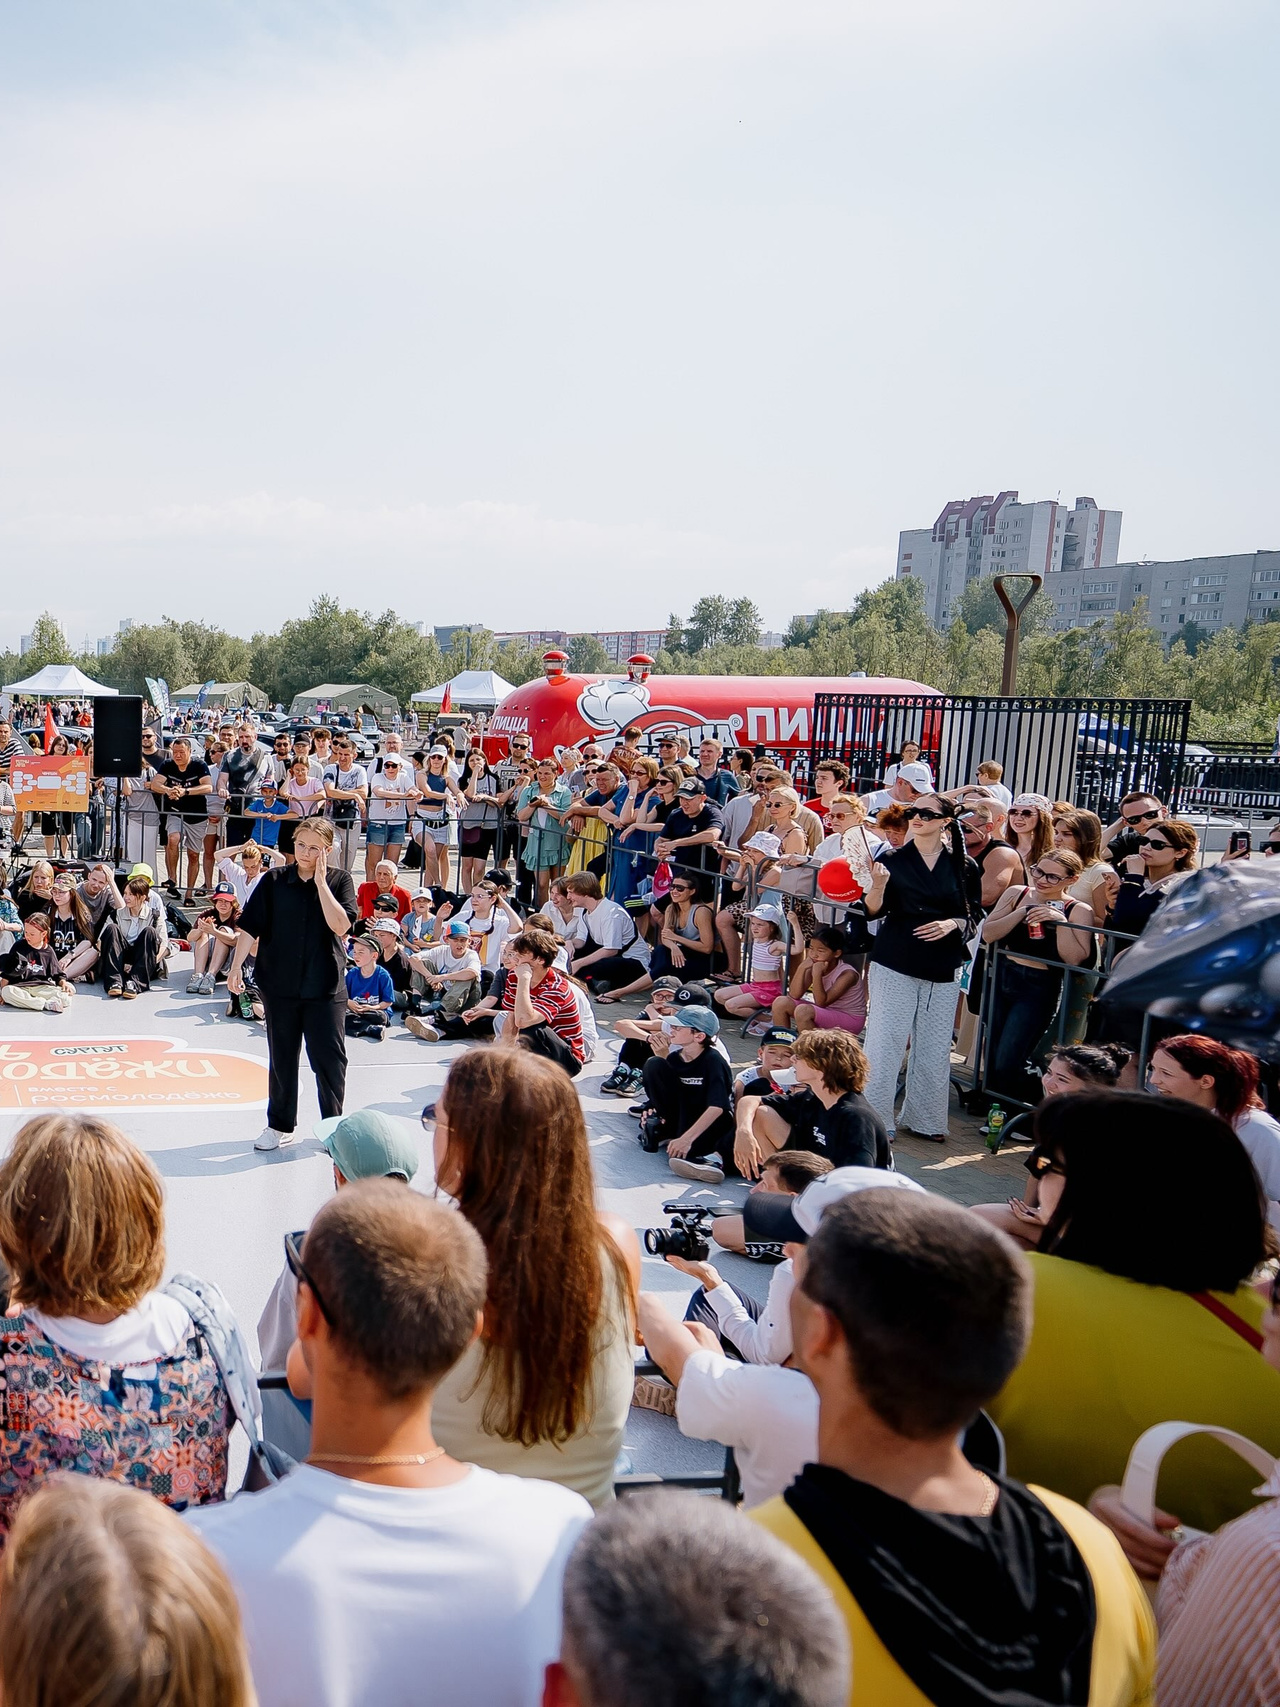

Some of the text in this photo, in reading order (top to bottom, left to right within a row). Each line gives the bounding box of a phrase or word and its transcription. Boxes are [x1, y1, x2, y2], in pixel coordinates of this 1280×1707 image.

[492, 715, 529, 734] ПИЦЦА
[53, 1045, 125, 1055] СУРГУТ
[31, 1091, 241, 1104] росмолодёжь
